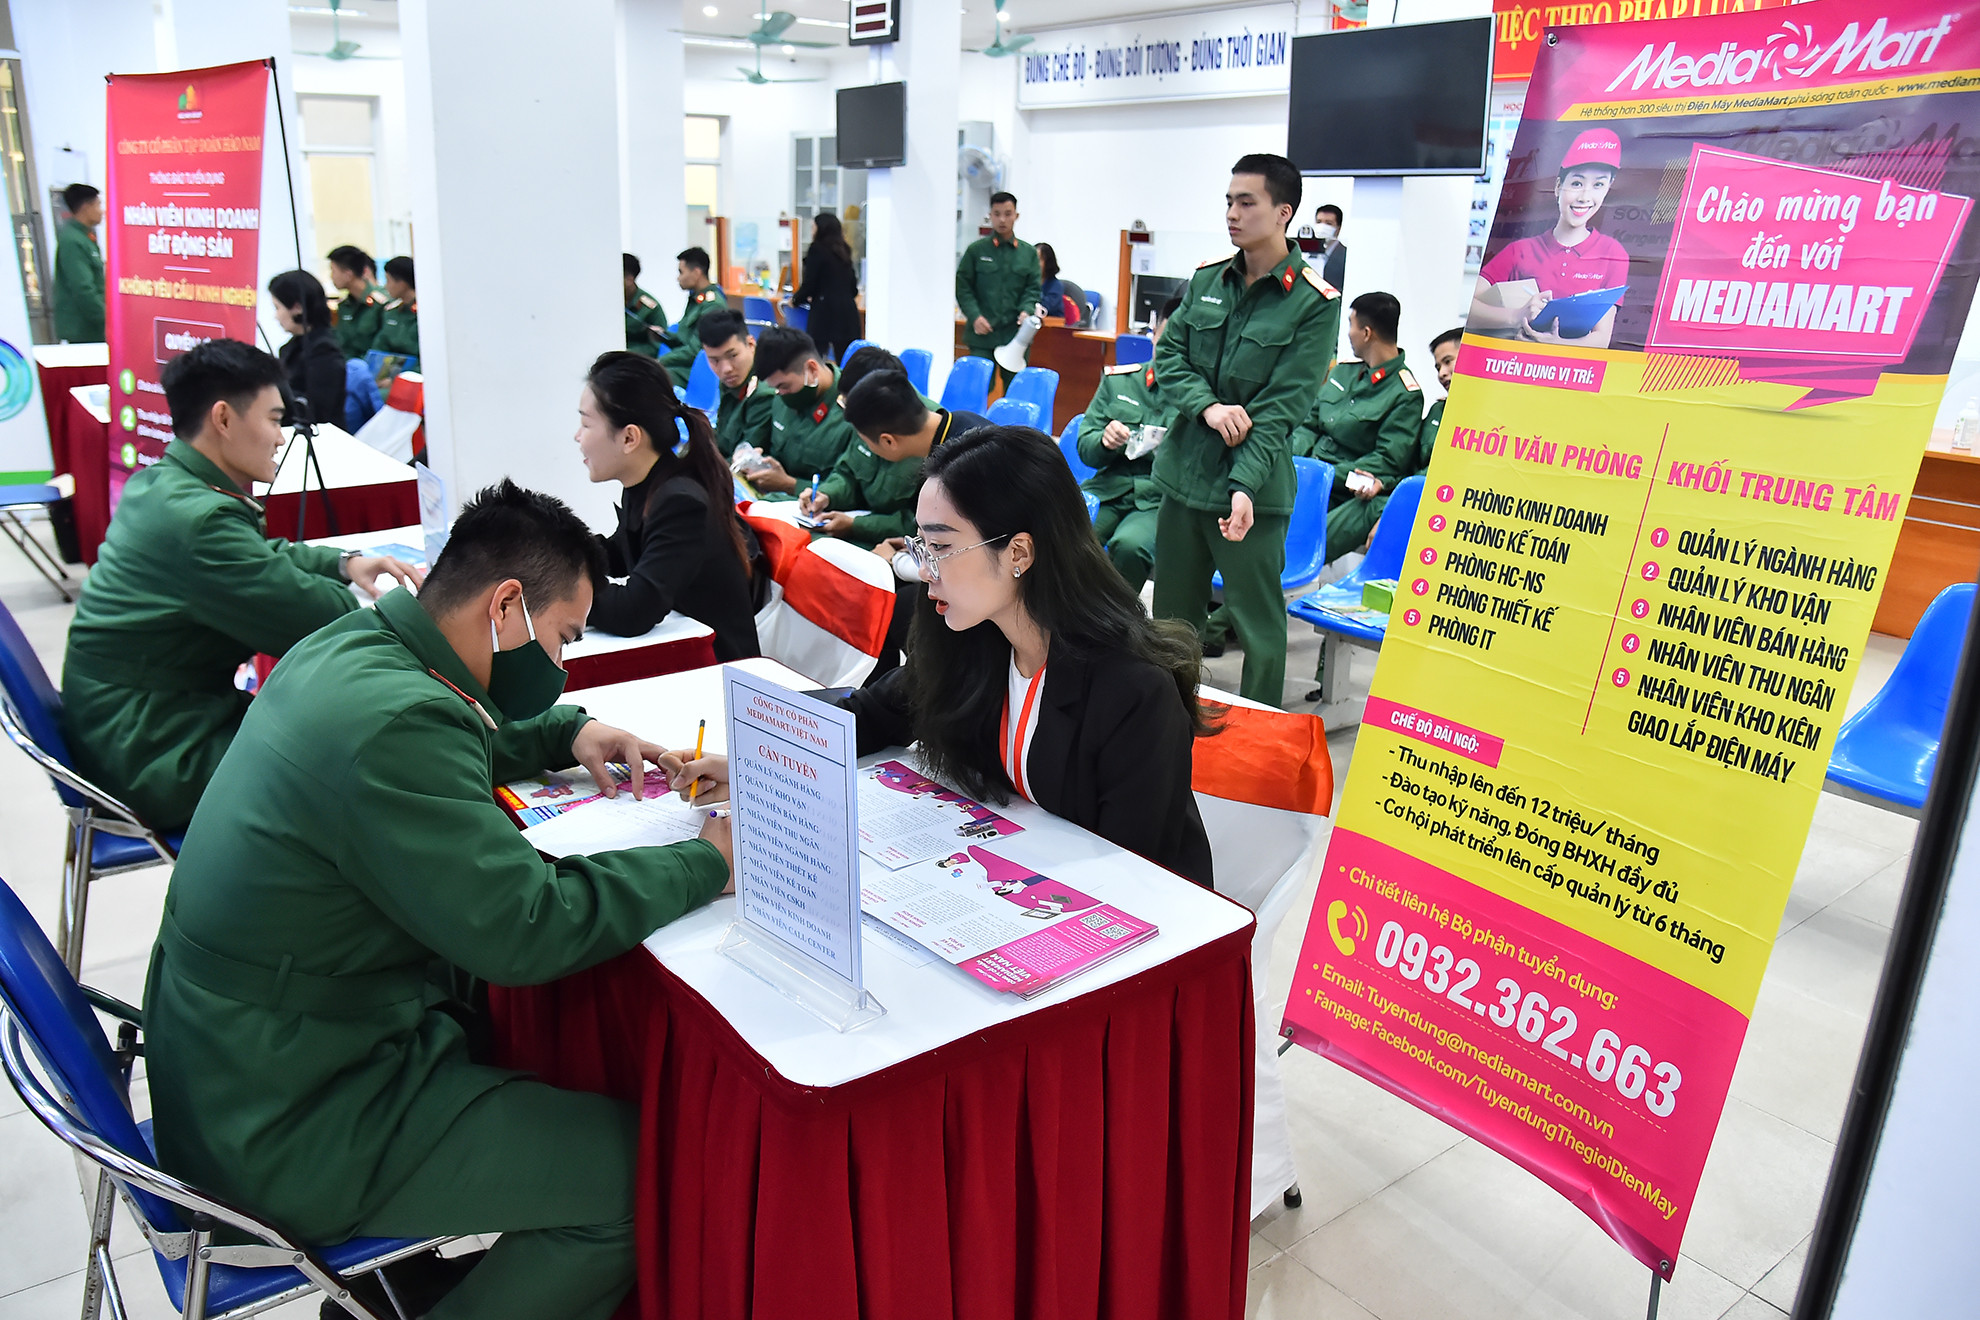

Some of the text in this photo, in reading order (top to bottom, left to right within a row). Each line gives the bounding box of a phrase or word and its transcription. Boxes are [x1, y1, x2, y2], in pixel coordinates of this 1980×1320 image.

[1496, 4, 1540, 50] IỆC
[1604, 14, 1952, 93] Media Mart
[1053, 42, 1070, 82] CHẾ
[1073, 44, 1086, 87] ĐỘ
[1095, 41, 1123, 79] ĐÚNG
[1126, 33, 1142, 77] ĐỐI
[1146, 40, 1180, 82] TƯỢNG
[1192, 31, 1223, 71] ĐÚNG
[1227, 26, 1253, 68] THỜI
[1256, 32, 1287, 66] GIAN
[1580, 107, 1593, 117] Hệ
[1593, 103, 1618, 117] thống
[1619, 105, 1636, 115] hơn
[1637, 104, 1655, 114] 300
[1656, 102, 1673, 113] siêu
[1675, 102, 1687, 113] thị
[1687, 100, 1710, 113] Điện
[1711, 99, 1732, 112] Máy
[1733, 96, 1788, 108] MediaMart
[1788, 93, 1810, 105] phủ
[1810, 90, 1834, 104] sóng
[1837, 89, 1860, 100] toàn
[1861, 84, 1889, 100] quốc
[123, 201, 260, 230] NHÂN VIÊN KINH DOANH
[1696, 179, 1938, 233] Chào mừng bạn
[148, 228, 233, 260] BẤT ĐỘNG SẢN
[1742, 230, 1845, 271] đến với
[1669, 279, 1913, 335] MEDIAMART
[1485, 355, 1595, 385] TUYỂN DỤNG VỊ TRÍ:
[1450, 426, 1644, 480] KHỐI VĂN PHÒNG
[1461, 487, 1609, 537] PHÒNG KINH DOANH
[1667, 459, 1902, 522] KHỐI TRUNG TÂM
[1453, 519, 1571, 565] PHÒNG KẾ TOÁN
[1677, 527, 1878, 593] QUẢN LÝ NGÀNH HÀNG
[1444, 551, 1546, 595] PHÒNG HC-NS
[1667, 565, 1832, 627] QUẢN LÝ KHO VẬN
[1427, 614, 1497, 651] PHÒNG IT
[1436, 583, 1560, 633] PHÒNG THIẾT KẾ
[1657, 603, 1849, 673] NHÂN VIÊN BÁN HÀNG
[1647, 638, 1836, 713] NHÂN VIÊN THU NGÂN
[746, 707, 828, 748] MEDIAMART VIỆT NAM
[753, 696, 774, 712] CÔNG
[775, 705, 785, 716] TY
[1390, 711, 1480, 754] CHẾ ĐỘ ĐÃI NGỘ:
[1636, 674, 1822, 752] NHÂN VIÊN KHO KIÊM
[1627, 710, 1797, 784] GIAO LẮP ĐIỆN MÁY
[774, 788, 791, 803] KHO
[1399, 745, 1660, 866] Thu nhập lên đến 12 triệu/ tháng
[1423, 785, 1447, 807] tạo
[1448, 794, 1468, 819] kỹ
[1469, 807, 1511, 837] năng,
[1514, 821, 1561, 858] Đóng
[1562, 840, 1617, 878] BHXH
[1617, 865, 1652, 895] đầy
[1653, 880, 1680, 905] đủ
[786, 893, 806, 910] CSKH
[1383, 797, 1726, 965] Cơ hội phát triển lên cấp quản lý từ 6 tháng
[1349, 866, 1619, 1011] Chi tiết liên hệ Bộ phận tuyển dụng:
[1375, 920, 1682, 1118] 0932.362.663
[1321, 962, 1615, 1139] Email: Tuyendung@mediamart.com.vn
[1313, 989, 1678, 1221] Fanpage: Facebook.com/TuyendungThegioiDienMay
